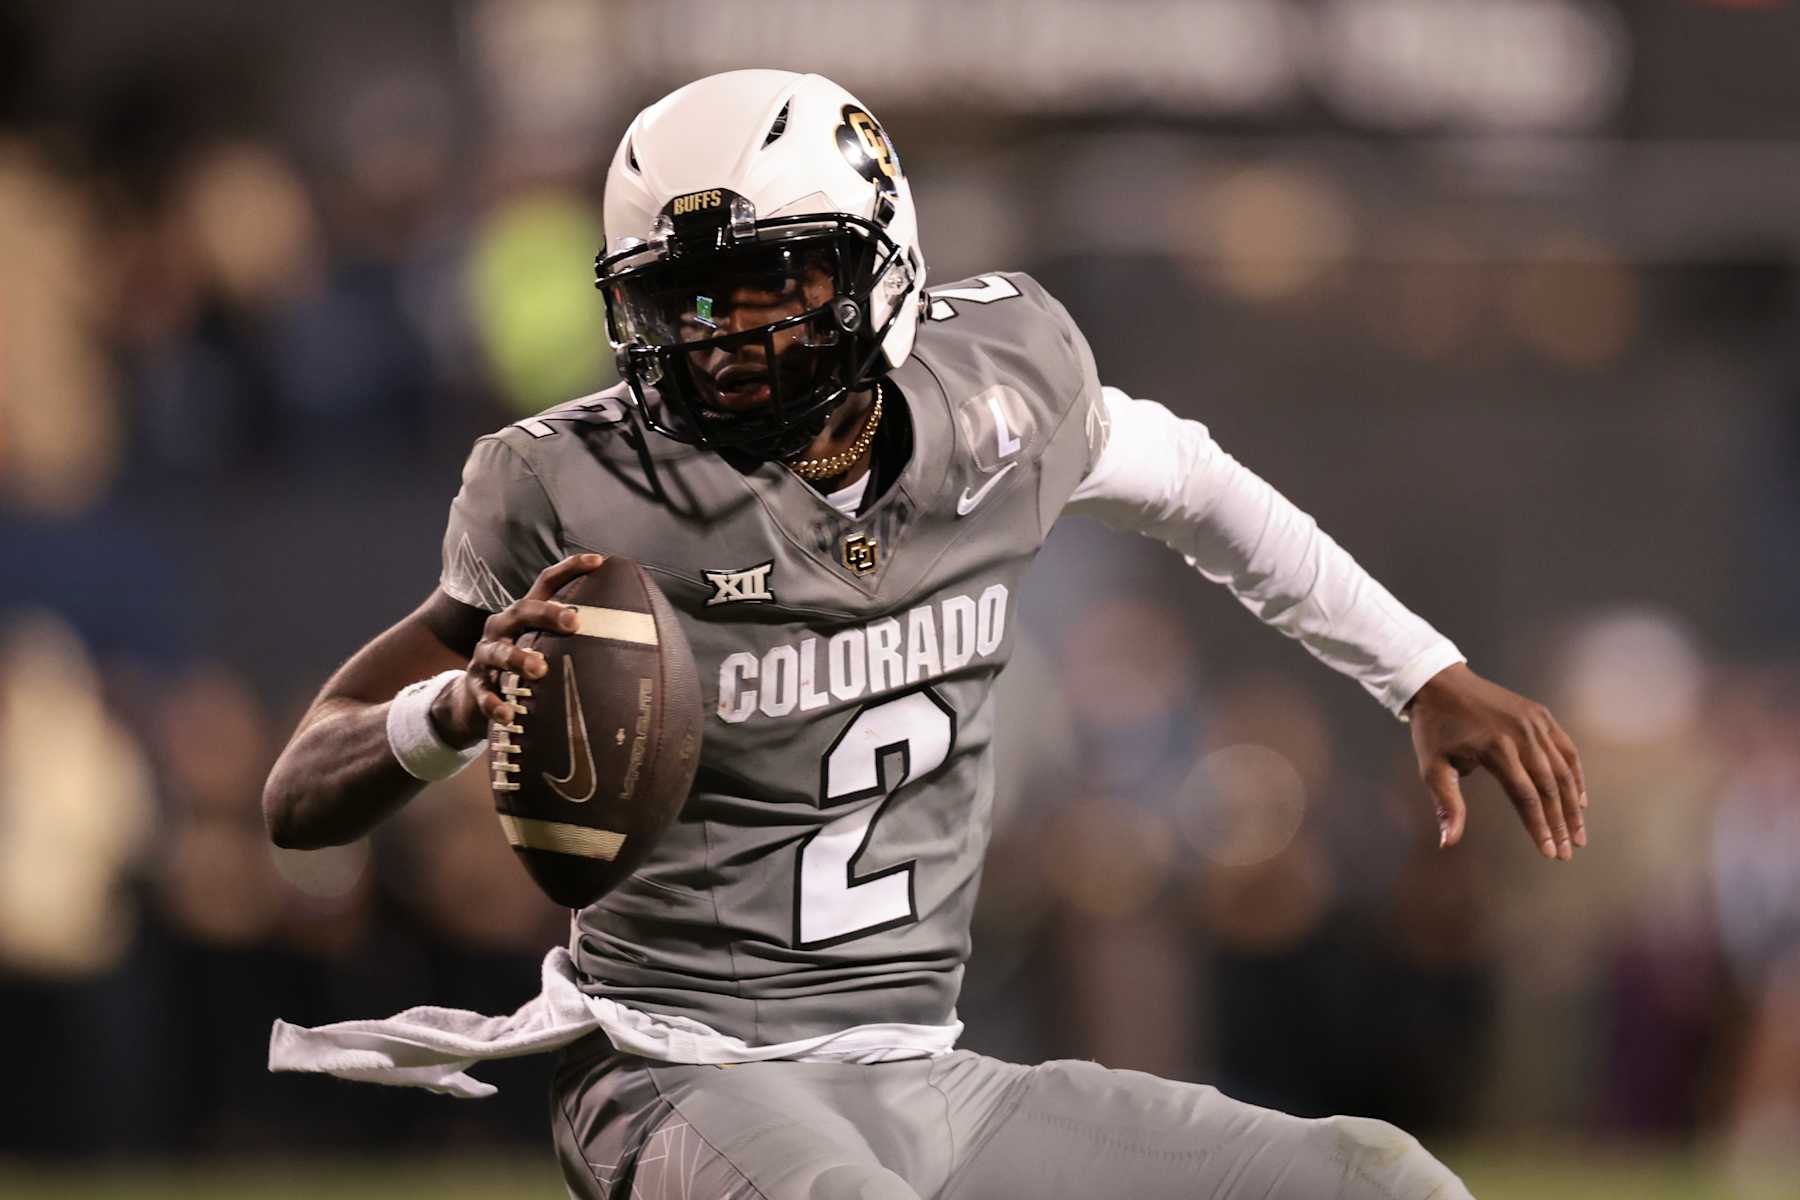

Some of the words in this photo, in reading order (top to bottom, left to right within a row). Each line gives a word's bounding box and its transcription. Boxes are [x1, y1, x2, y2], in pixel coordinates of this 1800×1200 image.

[673, 189, 722, 216] BUFFS
[717, 583, 1008, 724] COLORADO
[793, 687, 957, 950] 2
